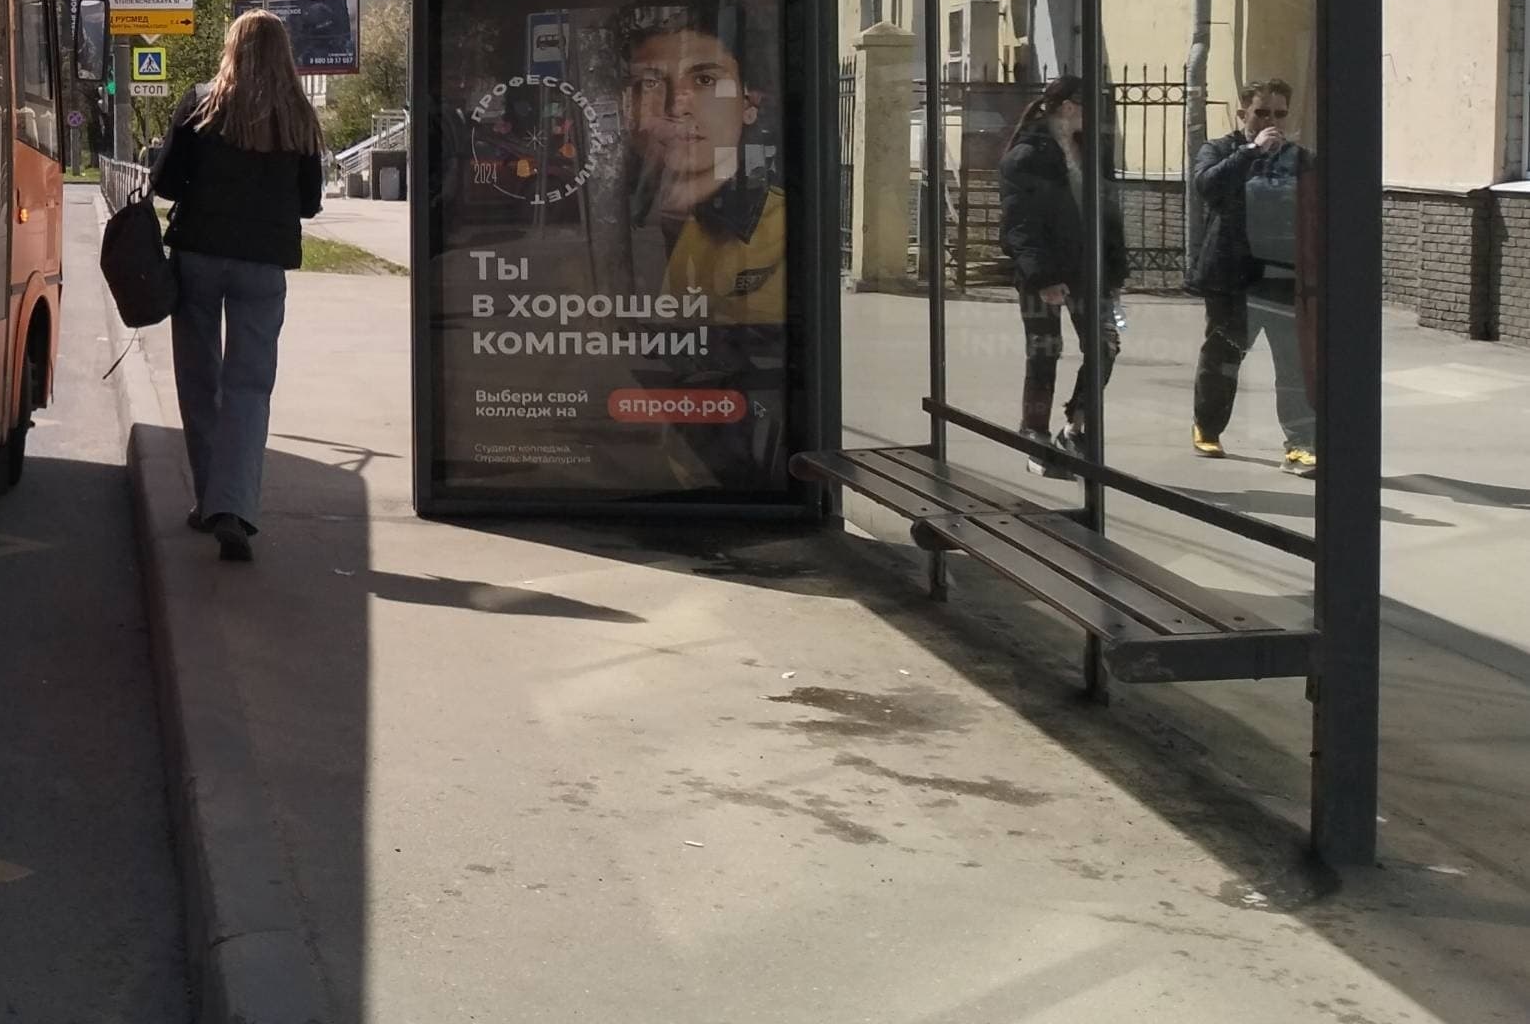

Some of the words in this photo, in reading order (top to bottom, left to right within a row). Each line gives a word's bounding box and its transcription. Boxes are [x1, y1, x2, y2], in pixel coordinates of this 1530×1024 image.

[115, 15, 149, 24] РУСМЕД
[133, 85, 164, 94] СТОП
[470, 74, 601, 206] ПРОФЕССИОНАЛИТЕТ
[473, 163, 498, 185] 2024
[469, 249, 530, 281] Ты
[472, 293, 495, 318] в
[507, 285, 709, 326] хорошей
[472, 325, 709, 357] компании!
[474, 389, 544, 406] Выбери
[547, 389, 589, 404] свой
[617, 394, 737, 416] япроф.рф
[474, 405, 553, 419] колледж
[556, 406, 578, 418] на
[473, 443, 516, 454] Студент
[522, 454, 592, 465] Металлургия
